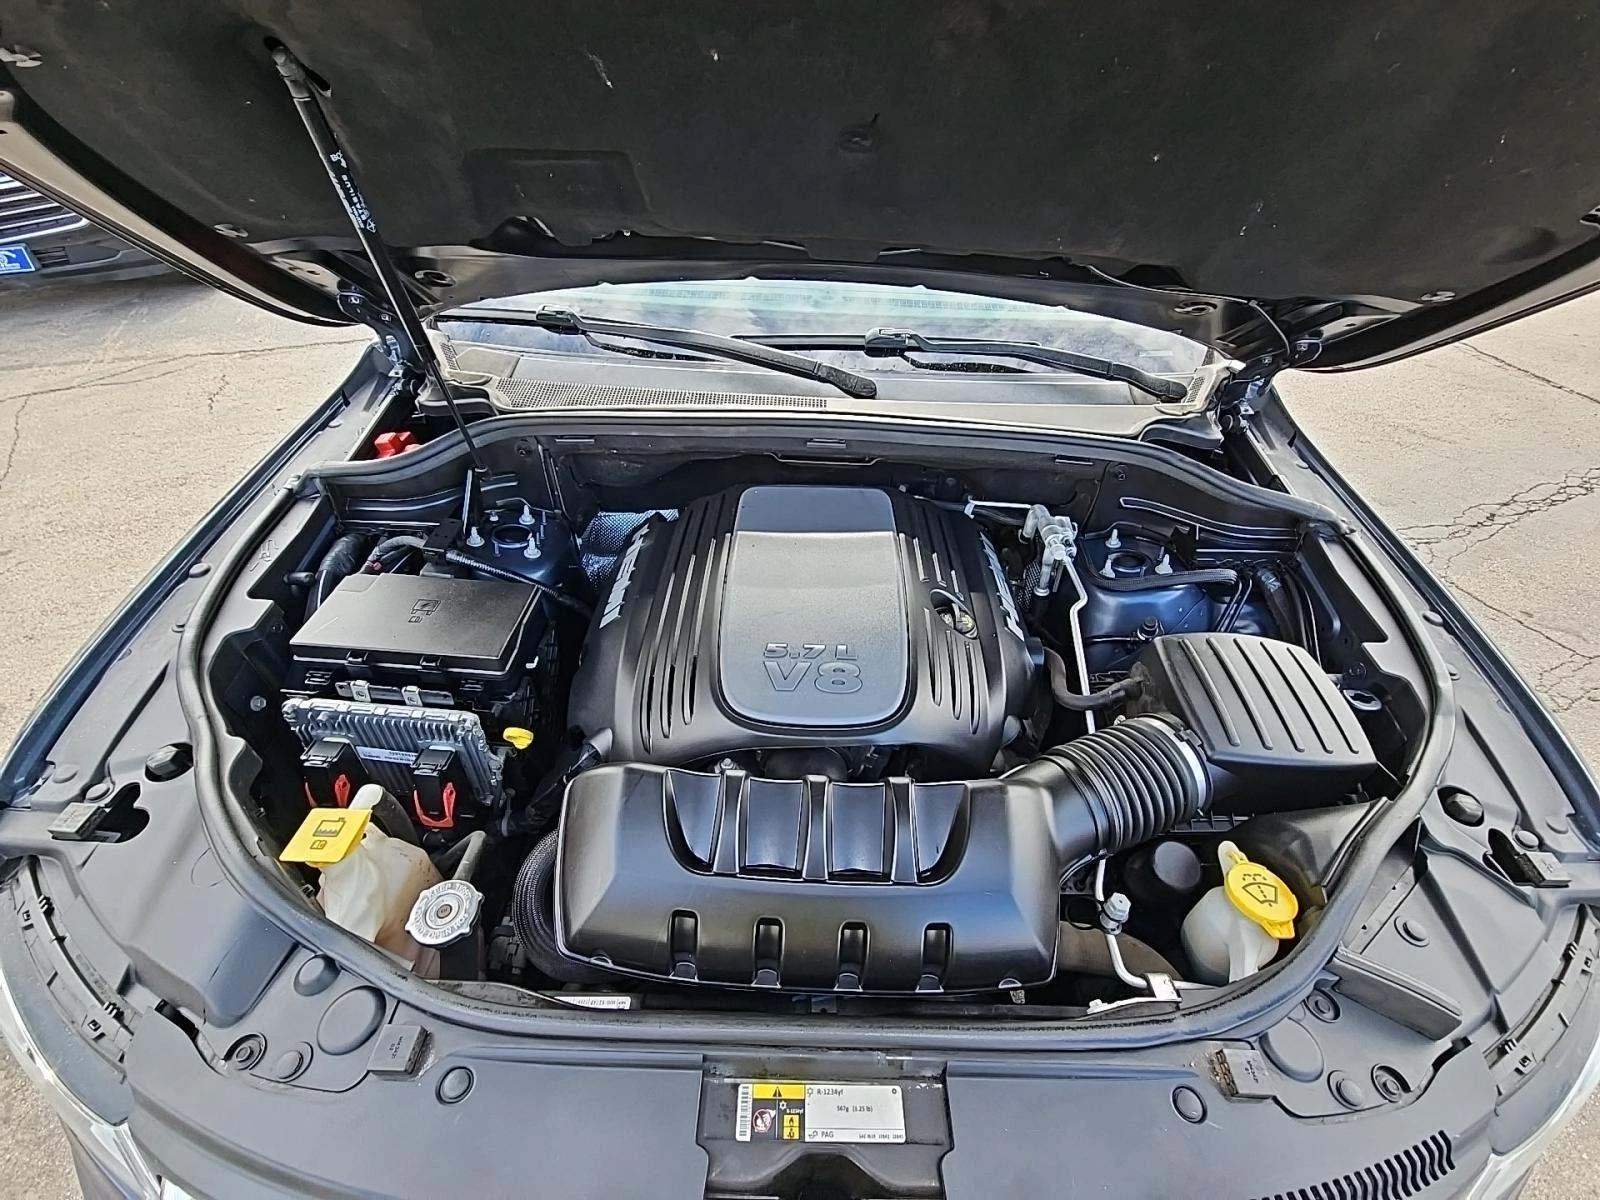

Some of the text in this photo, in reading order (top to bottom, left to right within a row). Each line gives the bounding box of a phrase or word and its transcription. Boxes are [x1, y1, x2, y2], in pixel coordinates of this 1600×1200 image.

[342, 174, 367, 220] STABILUS
[599, 522, 650, 629] HEMI
[979, 531, 1025, 642] HEMI
[763, 661, 863, 694] V8
[816, 1087, 844, 1097] R-1234yf
[821, 1131, 834, 1139] PAG
